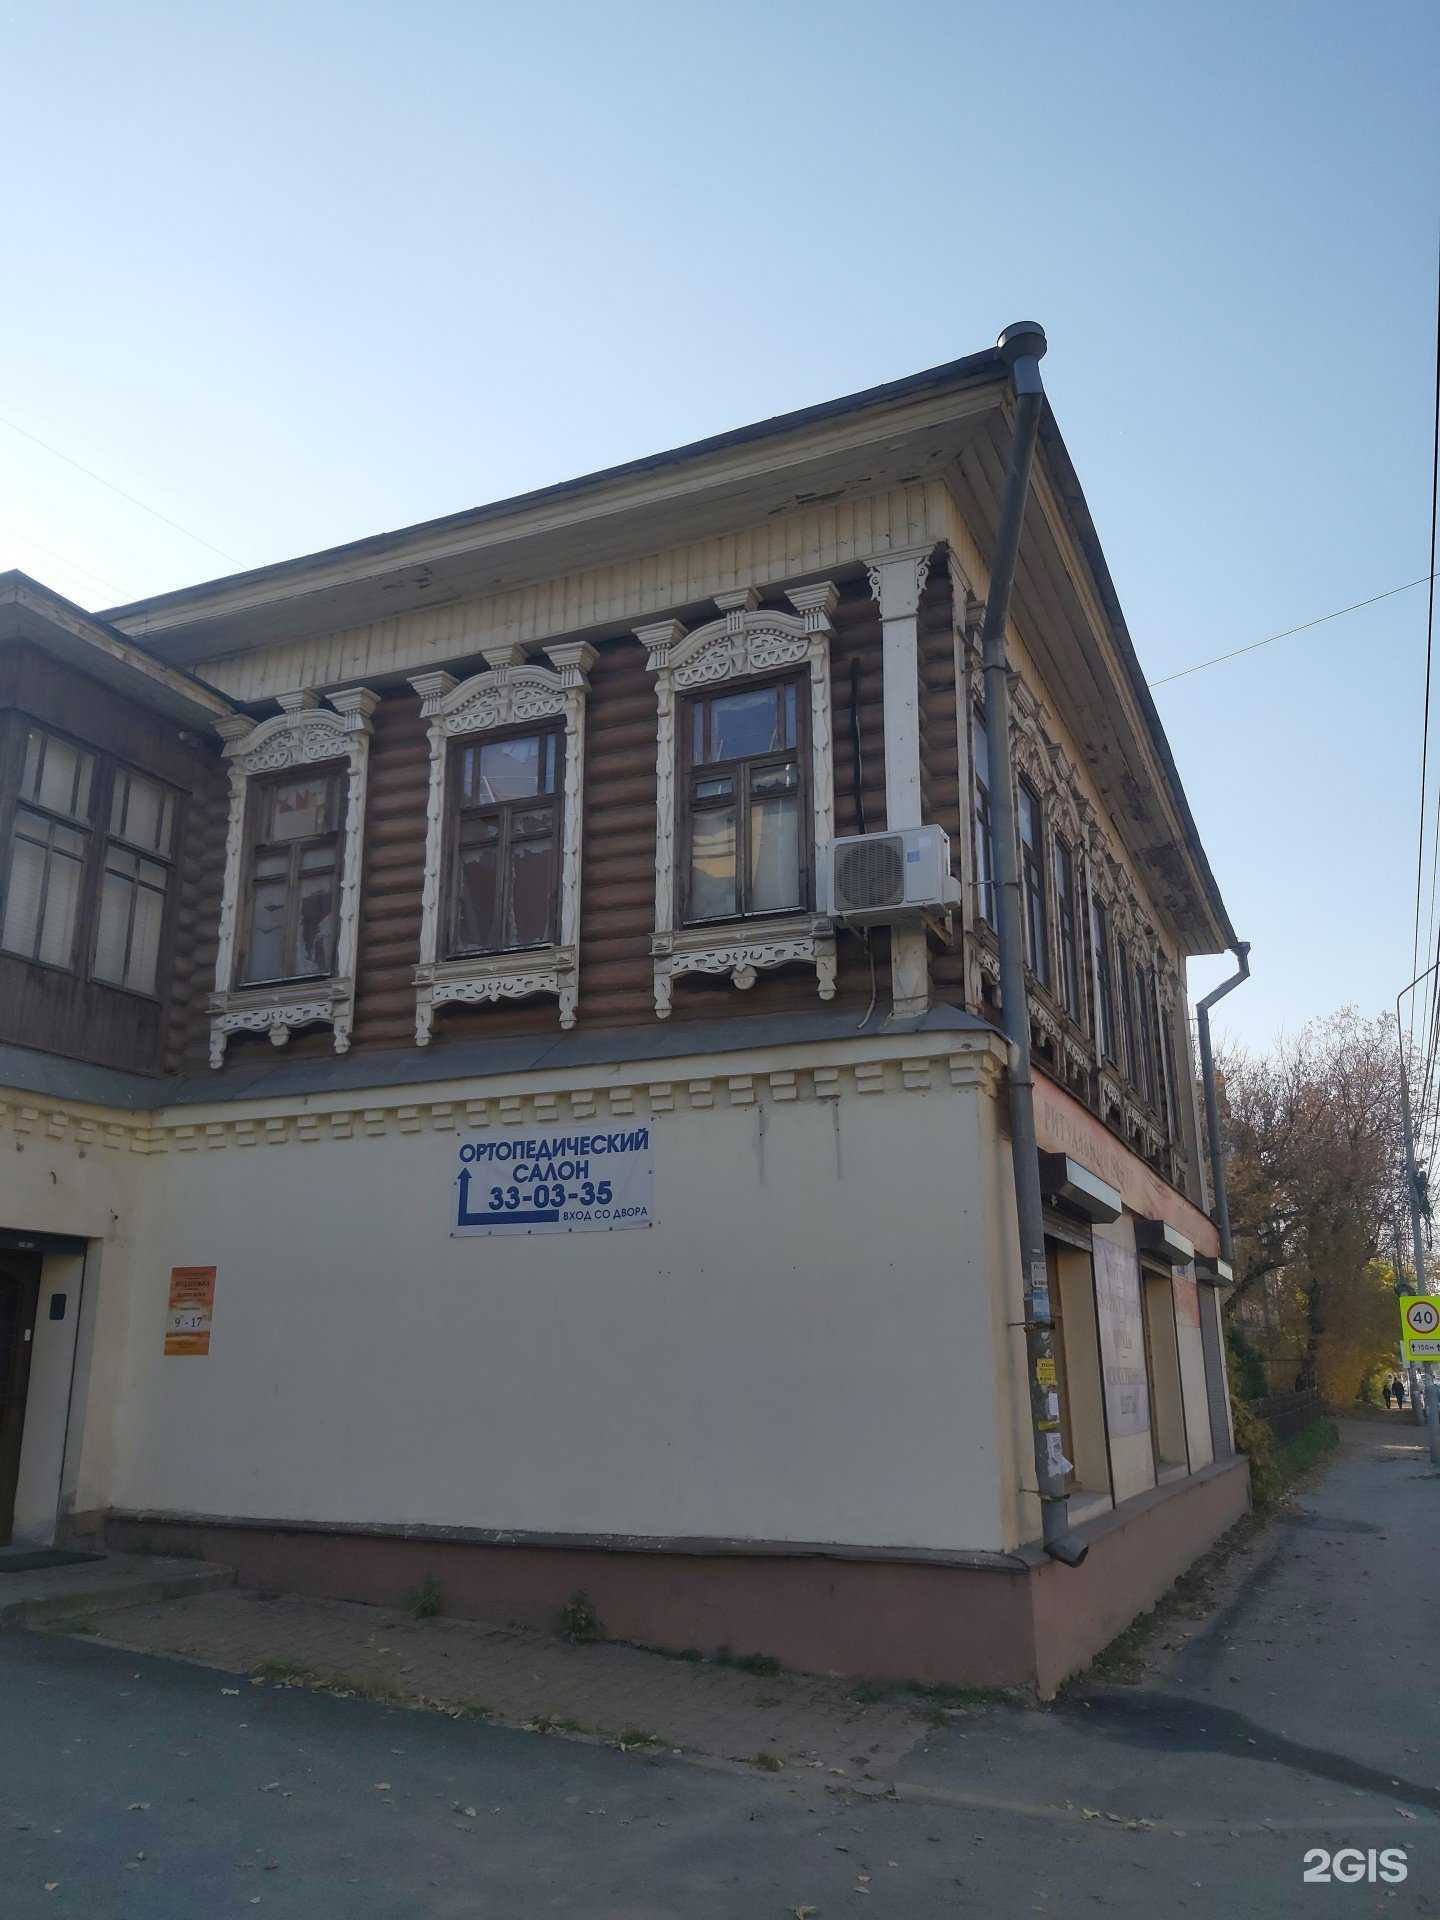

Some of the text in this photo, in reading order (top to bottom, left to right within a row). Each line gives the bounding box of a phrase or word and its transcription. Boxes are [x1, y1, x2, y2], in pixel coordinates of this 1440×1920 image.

[459, 1128, 649, 1163] ОРТОПЕДИЧЕСКИЙ
[512, 1160, 589, 1183] САЛОН
[488, 1181, 613, 1210] 33-03-35
[563, 1206, 648, 1221] ВХОД СО ДВОРА
[1413, 1311, 1433, 1324] 40
